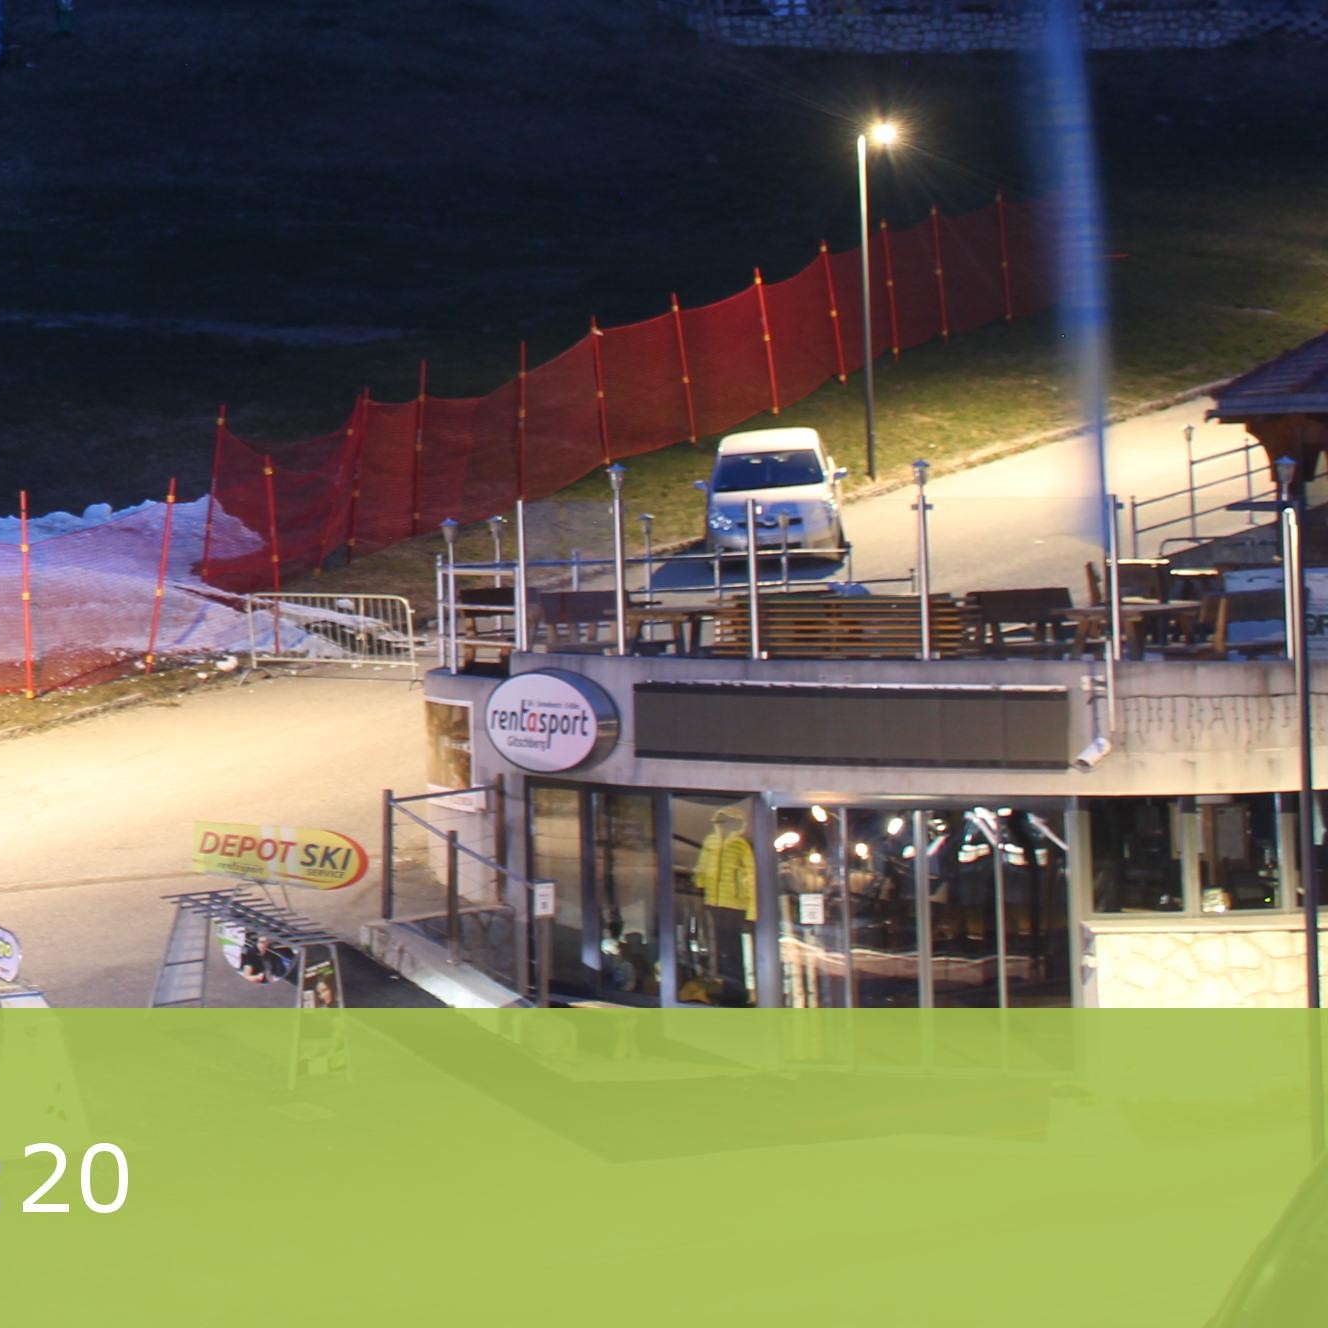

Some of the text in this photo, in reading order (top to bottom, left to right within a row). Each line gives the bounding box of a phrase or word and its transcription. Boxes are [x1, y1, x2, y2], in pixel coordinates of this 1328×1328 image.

[491, 699, 588, 749] rentasport
[199, 831, 352, 870] DEPOT SKI
[307, 868, 345, 880] SERVICE
